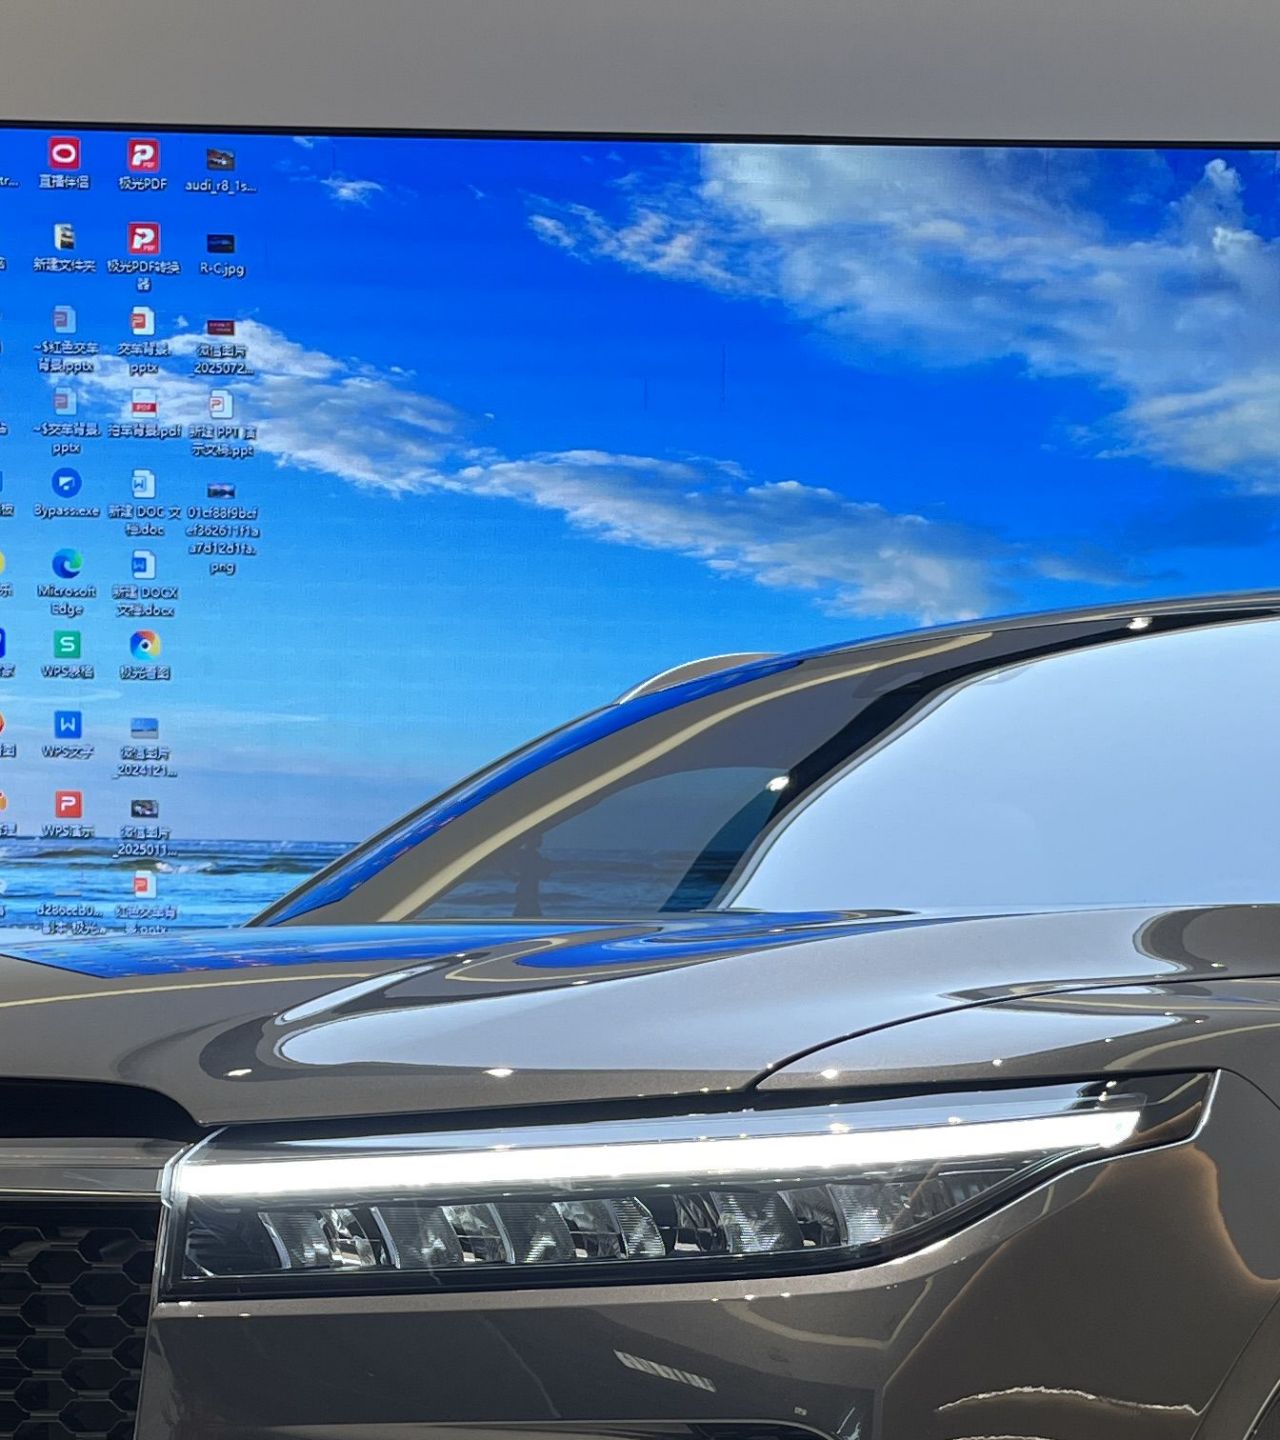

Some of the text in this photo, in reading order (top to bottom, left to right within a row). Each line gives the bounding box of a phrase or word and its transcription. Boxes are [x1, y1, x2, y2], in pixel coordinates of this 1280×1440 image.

[39, 174, 89, 189] 直播伴侣
[119, 176, 167, 190] 极光PDF
[33, 257, 97, 272] 新建文件夹
[200, 262, 245, 277] R-C.jpg
[131, 363, 159, 376] pptx
[52, 443, 80, 456] pptx
[34, 503, 100, 519] Bypass.exe
[137, 504, 163, 518] DOC
[210, 562, 235, 576] png
[38, 584, 97, 597] Microsoft
[141, 586, 178, 599] DOCX
[51, 602, 84, 618] Edge
